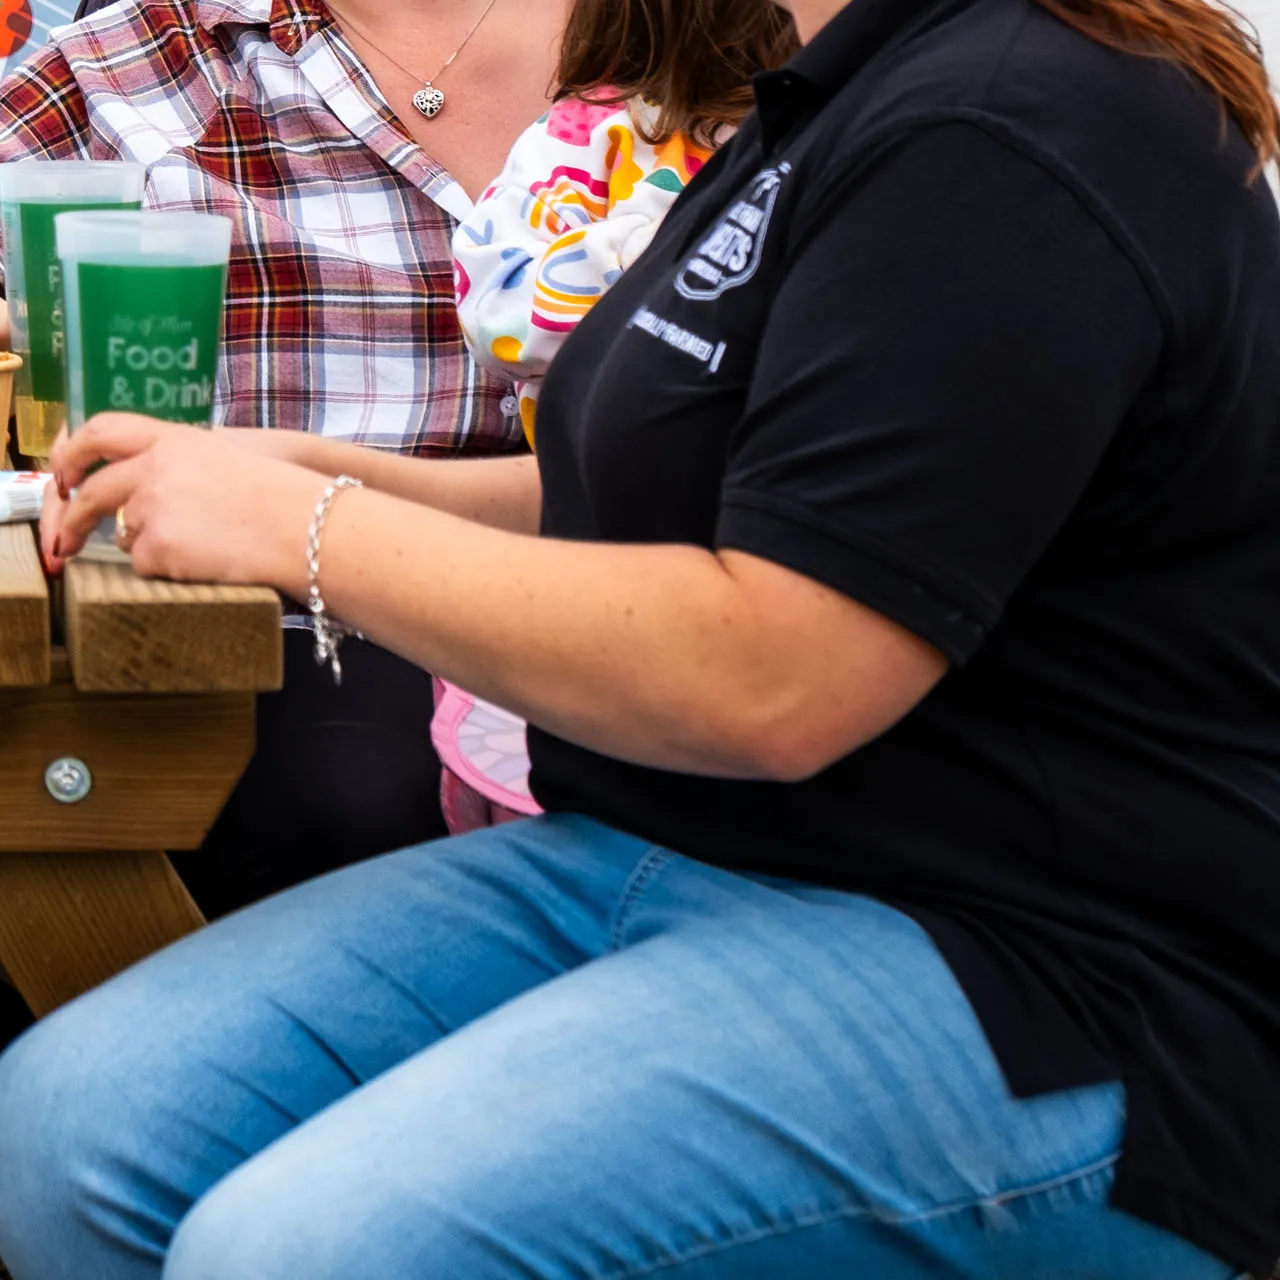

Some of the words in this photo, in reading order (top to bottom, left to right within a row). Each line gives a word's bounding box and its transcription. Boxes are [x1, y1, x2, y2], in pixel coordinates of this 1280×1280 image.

[107, 336, 199, 370] Food
[109, 375, 135, 408] &
[145, 375, 213, 409] Drink
